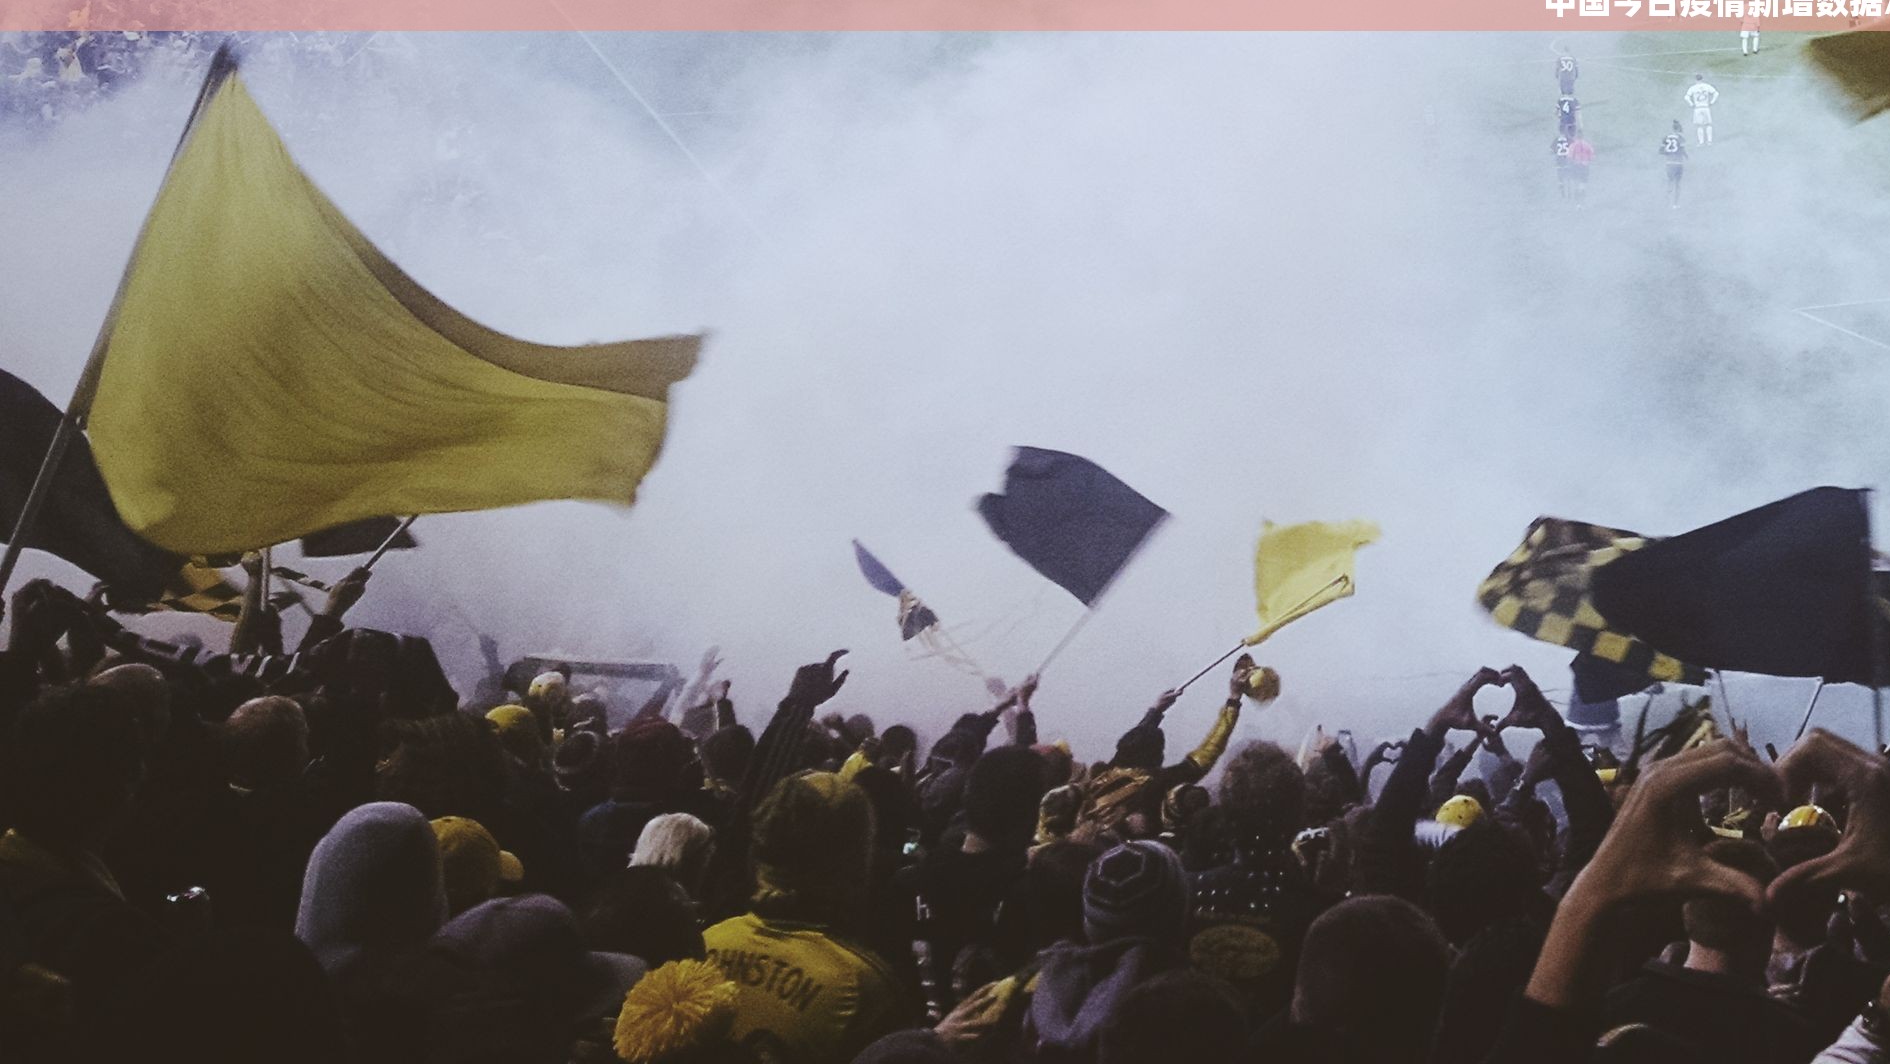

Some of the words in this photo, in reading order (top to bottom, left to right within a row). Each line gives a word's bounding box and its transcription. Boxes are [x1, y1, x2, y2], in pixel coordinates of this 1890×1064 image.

[1560, 60, 1574, 72] 30
[1562, 101, 1570, 114] 4
[1557, 142, 1570, 156] 25
[1664, 139, 1678, 153] 23
